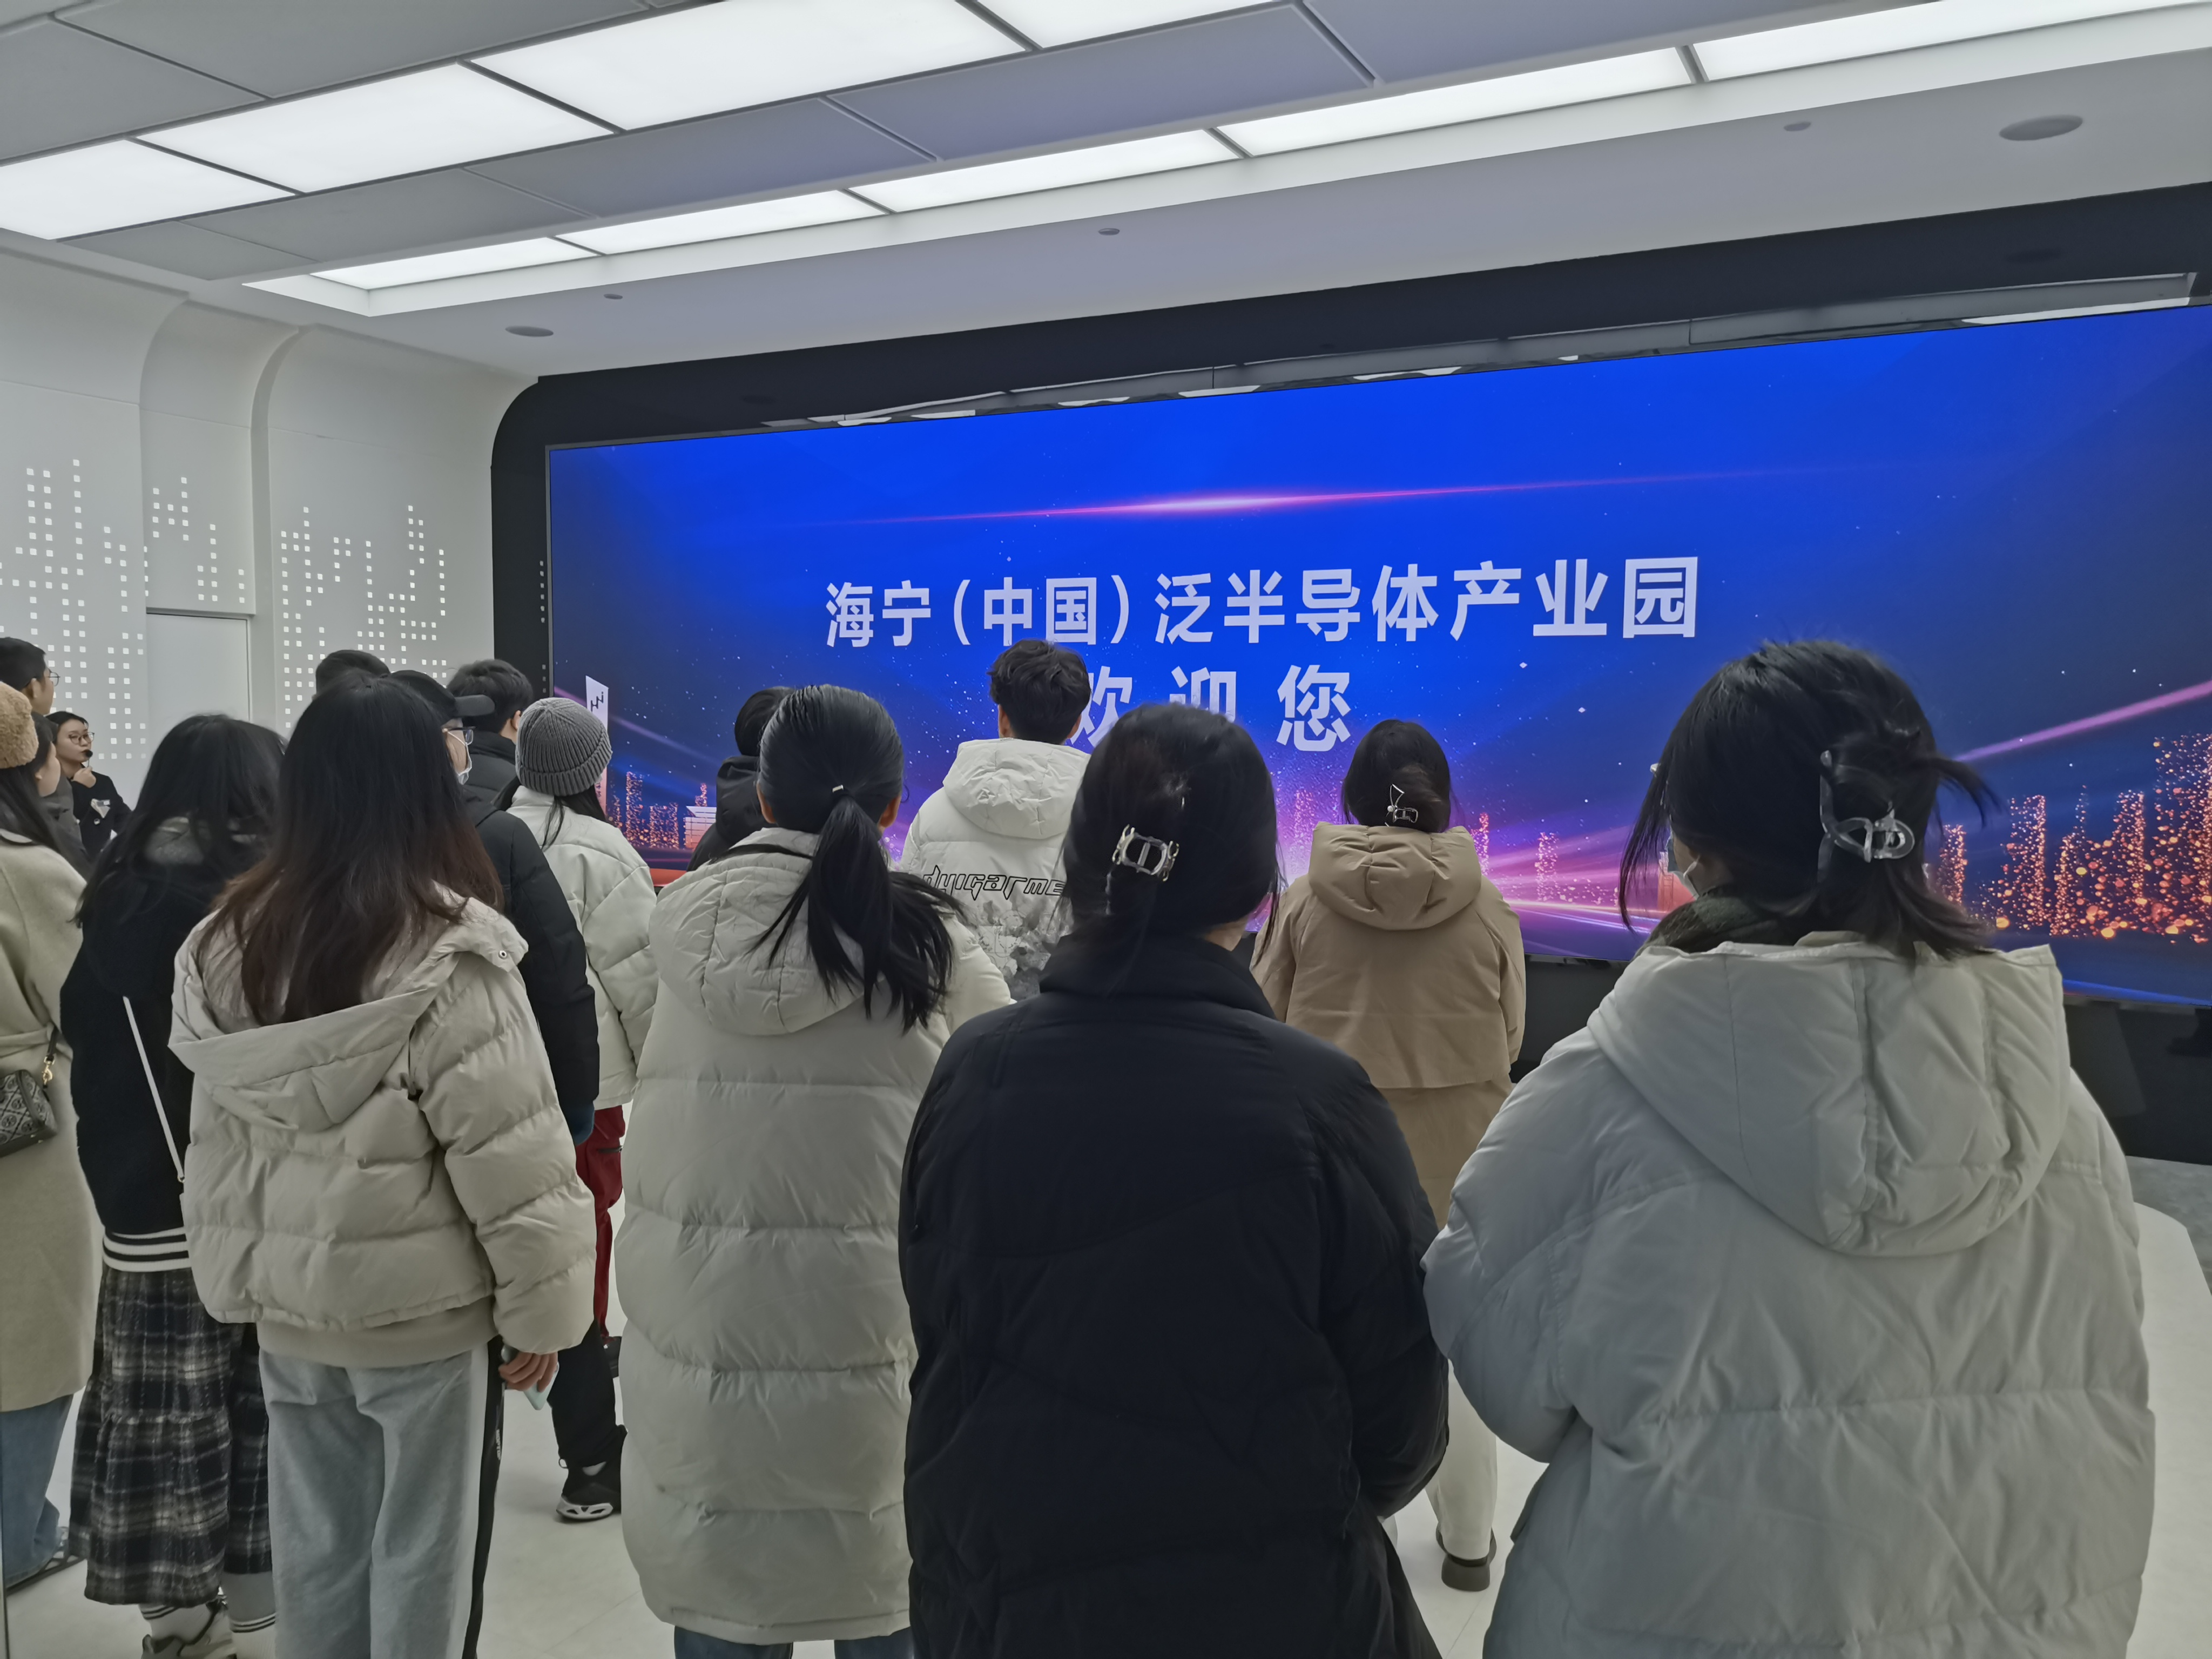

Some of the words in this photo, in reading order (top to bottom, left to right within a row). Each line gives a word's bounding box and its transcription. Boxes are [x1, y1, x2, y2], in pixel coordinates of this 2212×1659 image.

[826, 556, 1699, 648] 海宁（中国）泛半导体产业园
